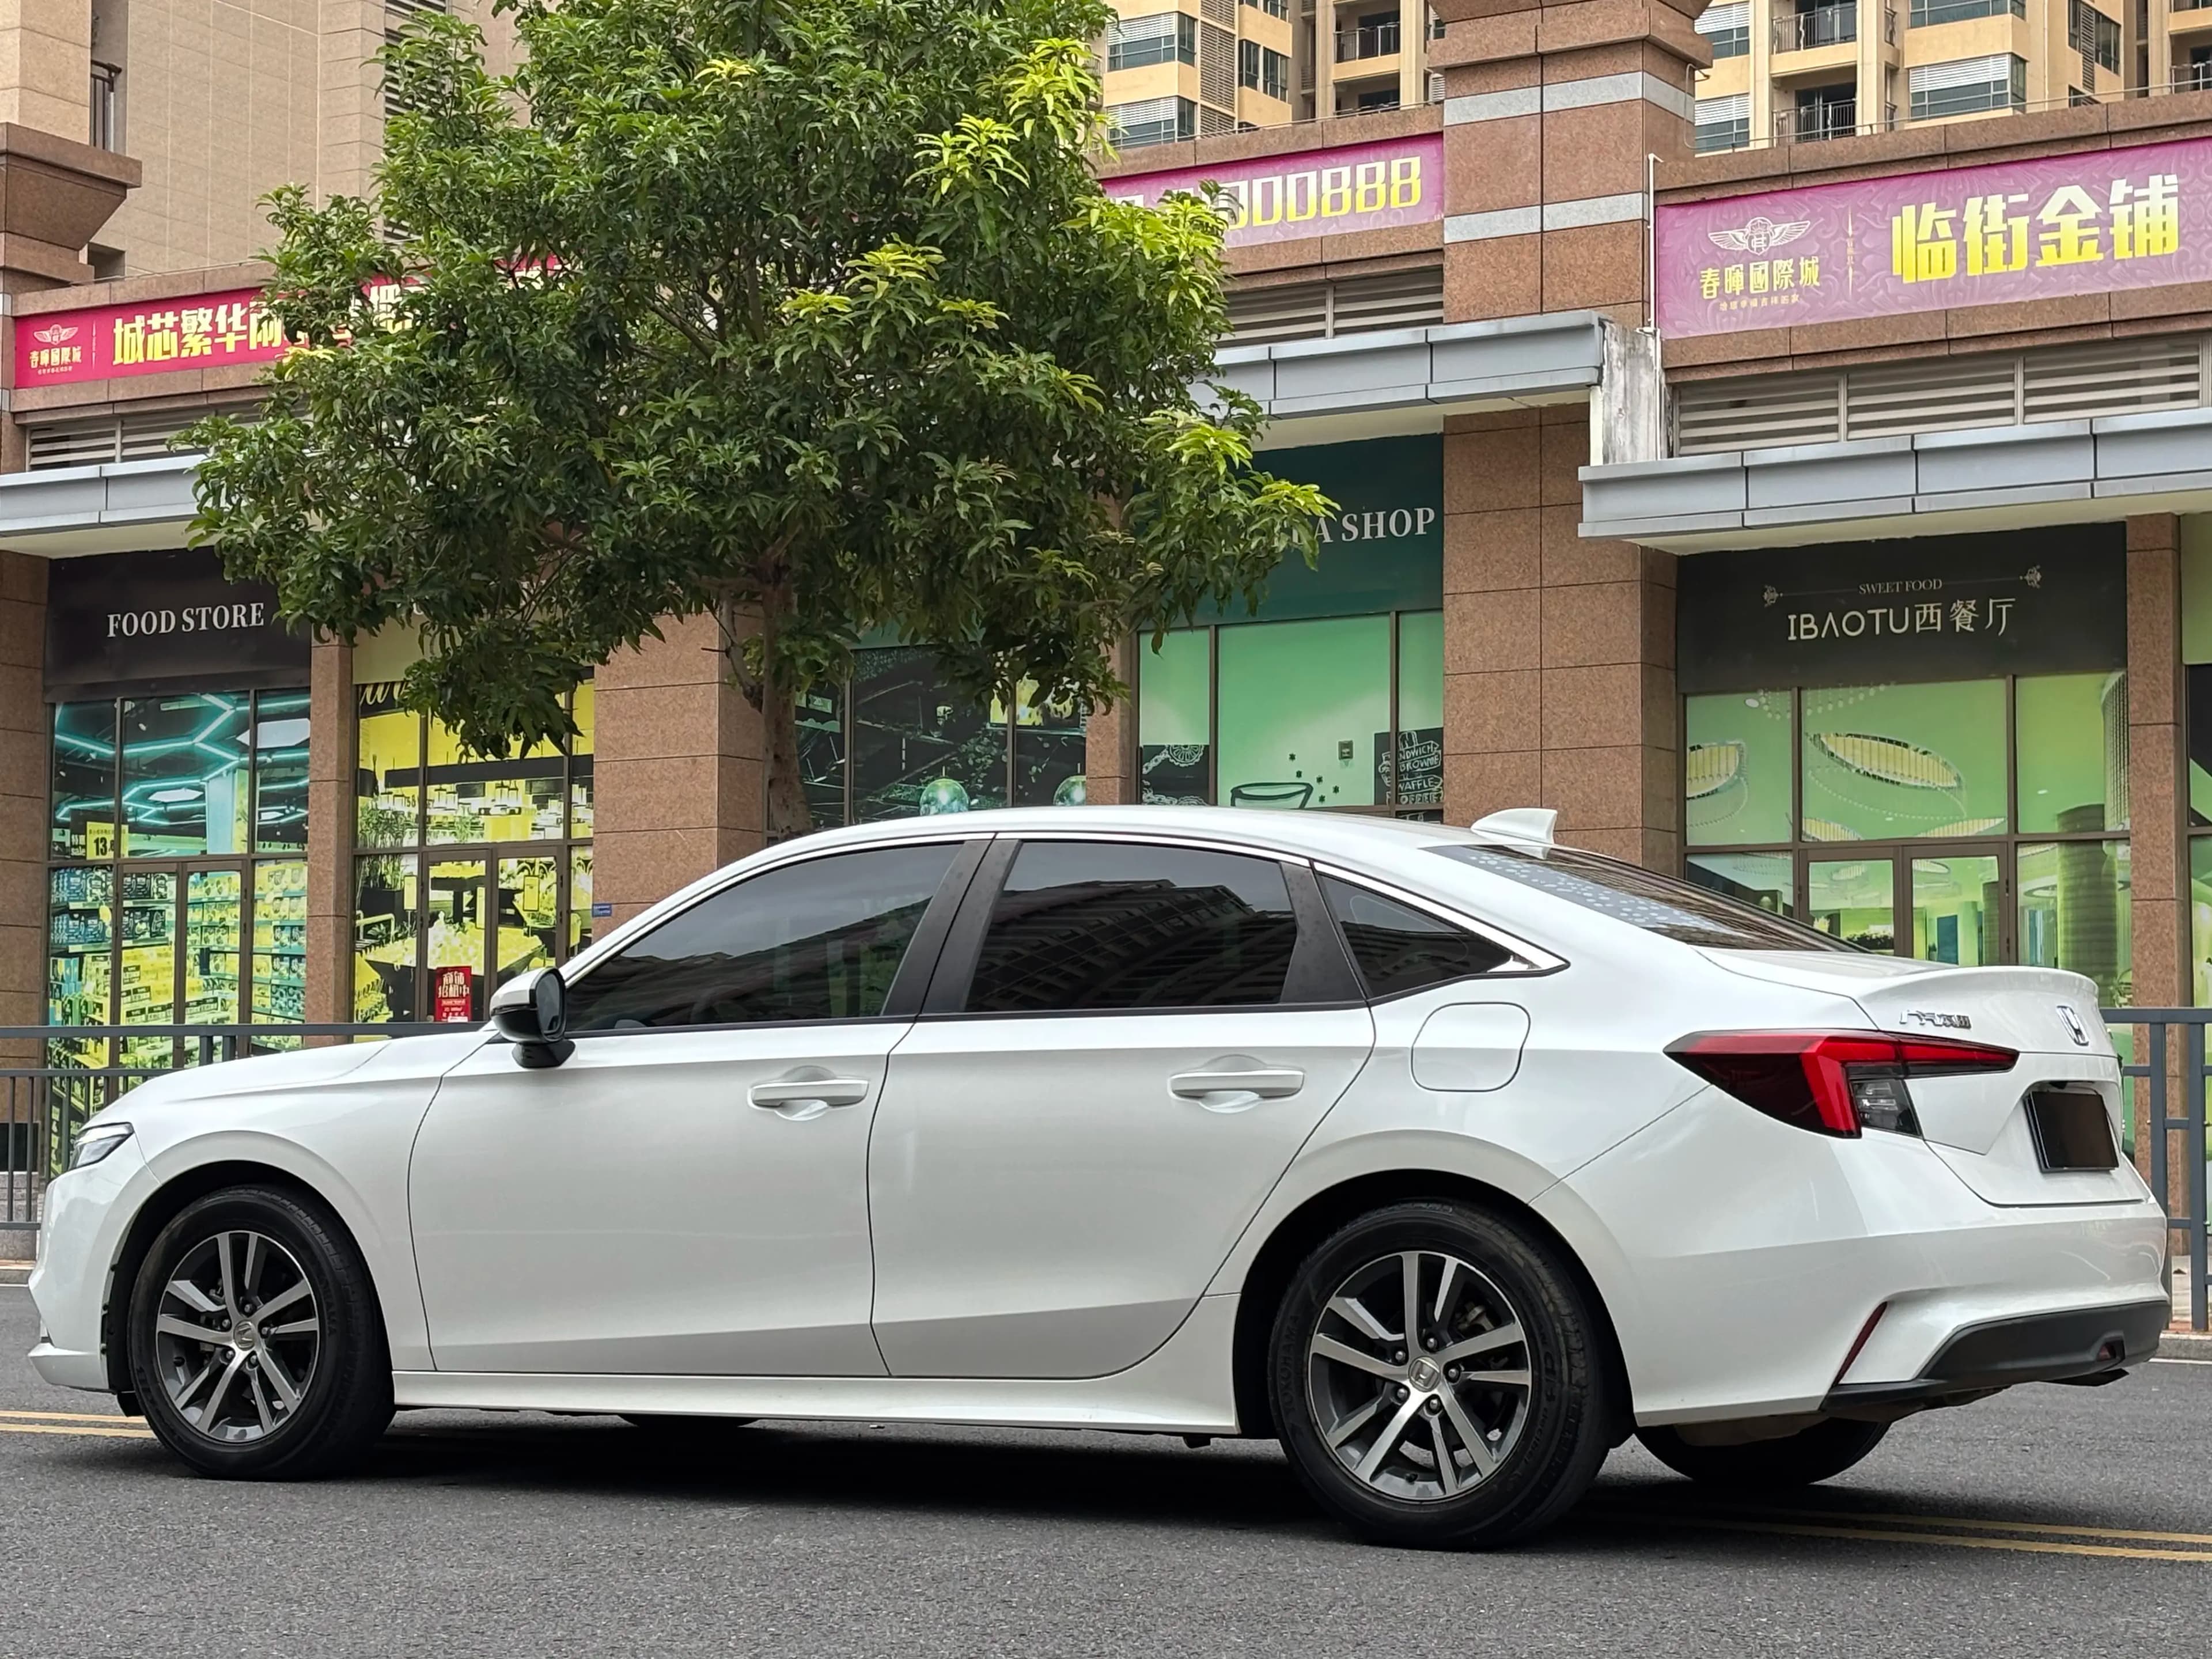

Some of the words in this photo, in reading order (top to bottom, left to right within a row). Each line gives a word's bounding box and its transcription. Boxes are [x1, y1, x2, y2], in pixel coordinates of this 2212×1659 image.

[1891, 173, 2180, 283] 临街金铺
[1341, 507, 1435, 543] SHOP
[1858, 581, 1902, 595] SWEET
[1904, 578, 1943, 592] FOOD
[107, 609, 176, 638] FOOD
[181, 602, 264, 632] STORE
